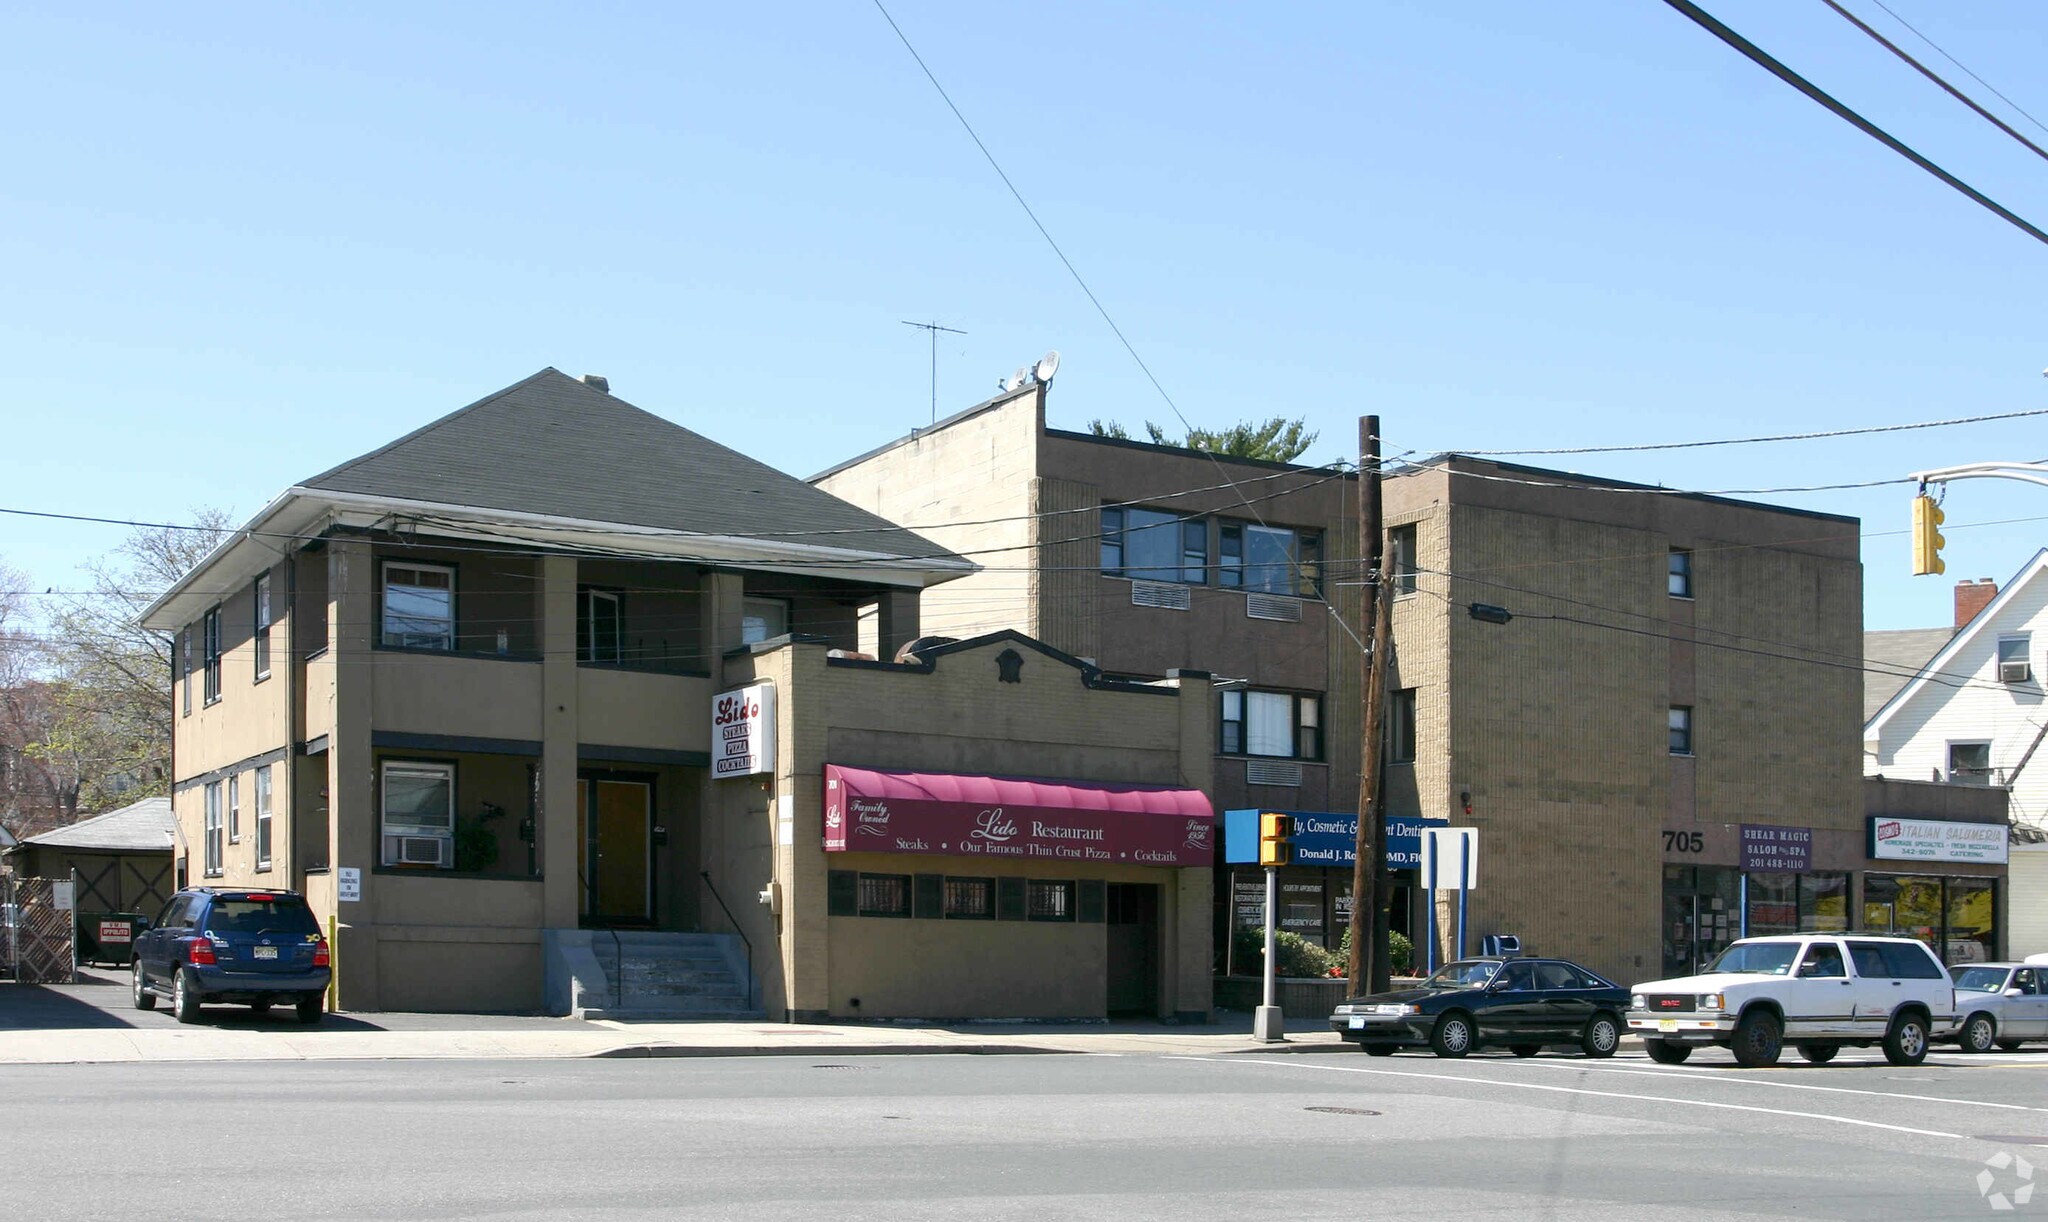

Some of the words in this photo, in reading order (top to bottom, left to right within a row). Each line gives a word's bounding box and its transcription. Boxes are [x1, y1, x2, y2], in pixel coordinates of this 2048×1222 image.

[715, 697, 758, 725] Lido
[724, 724, 751, 739] STEAKS
[727, 741, 747, 754] PIZZA
[719, 757, 756, 771] COCKTAILS
[850, 800, 887, 816] Family
[859, 811, 890, 823] Owned
[971, 808, 1018, 841] Lido
[1032, 821, 1104, 840] Restaurant
[1186, 820, 1209, 831] Since
[1307, 818, 1347, 834] Cosmetic
[1396, 823, 1424, 837] Denti
[1744, 829, 1775, 840] SHEAR
[1779, 831, 1809, 842] MAGIC
[1901, 826, 1941, 839] ITALIAN
[1946, 828, 2001, 842] SALUMERIA
[896, 838, 929, 850] Steaks
[1662, 831, 1703, 853] 705
[960, 841, 982, 852] Our
[986, 841, 1024, 854] Famous
[1026, 843, 1052, 856] Thin
[1055, 845, 1081, 857] Crust
[1085, 847, 1111, 859] Pizza
[1134, 849, 1177, 862] Cocktails
[1299, 848, 1334, 859] Donald
[1335, 850, 1342, 862] J.
[1386, 852, 1408, 864] MD,
[1747, 844, 1777, 855] SALON
[1789, 846, 1806, 856] SPA
[1750, 858, 1764, 867] 201
